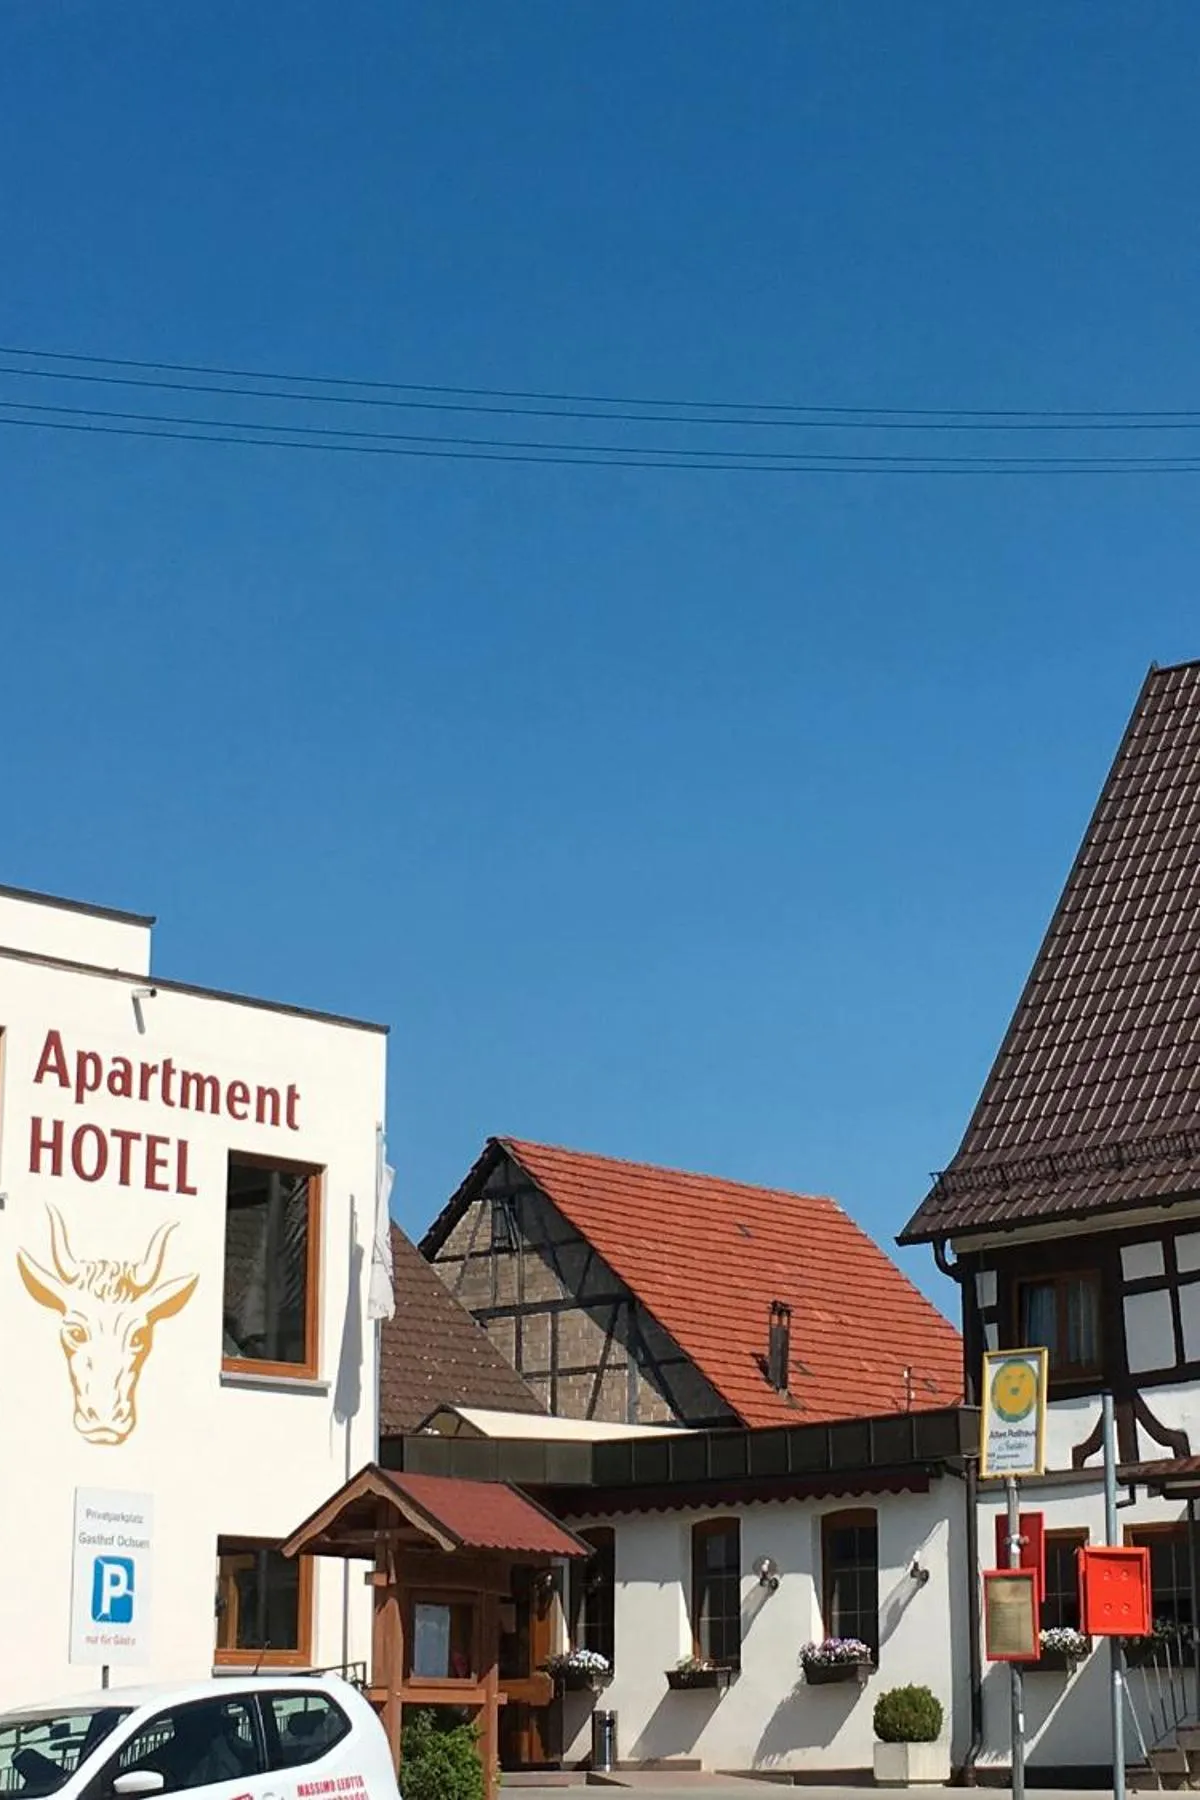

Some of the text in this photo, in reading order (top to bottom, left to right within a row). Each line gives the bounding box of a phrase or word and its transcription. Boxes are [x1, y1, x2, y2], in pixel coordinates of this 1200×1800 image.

[33, 1028, 301, 1131] Apartment
[29, 1116, 198, 1195] HOTEL
[85, 1507, 144, 1525] Privatparkplatz
[78, 1531, 115, 1547] Gasthof
[101, 1563, 128, 1615] P
[297, 1779, 336, 1797] MASSIMO
